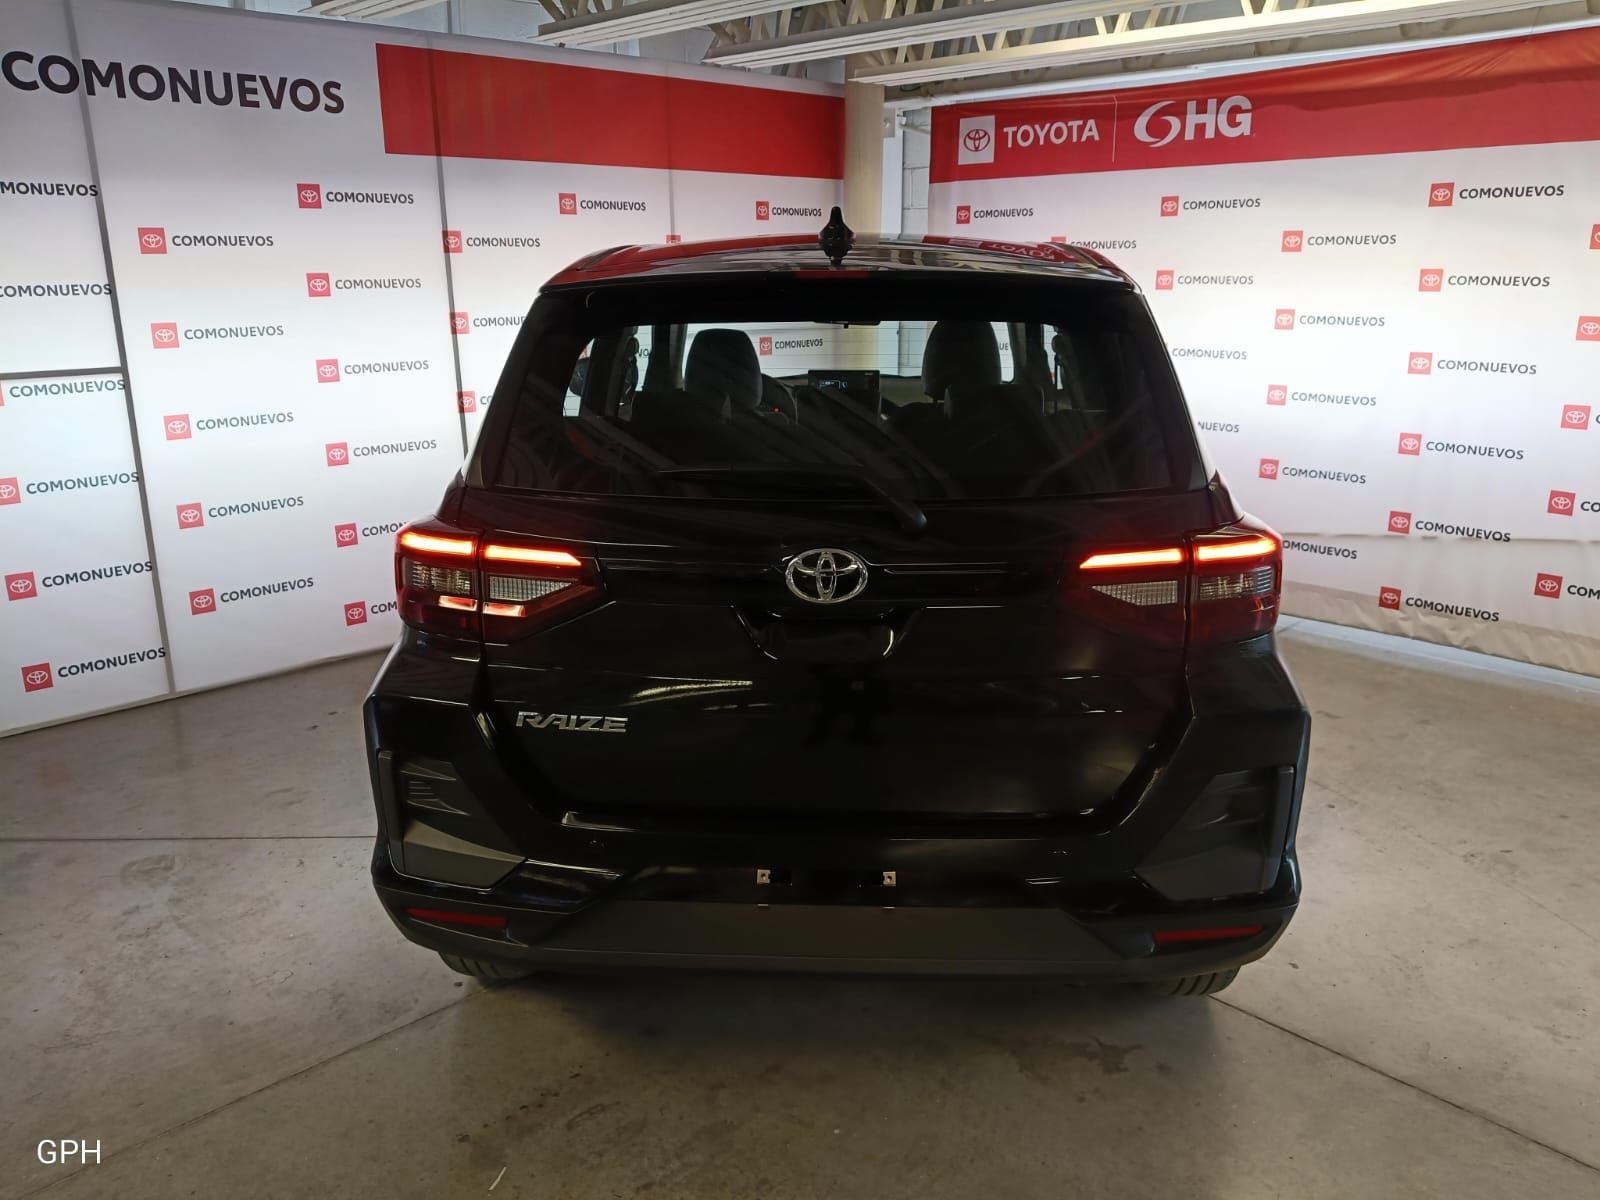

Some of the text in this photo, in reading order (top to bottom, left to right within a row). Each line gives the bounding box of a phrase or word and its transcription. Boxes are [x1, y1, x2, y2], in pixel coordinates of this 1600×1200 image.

[0, 50, 345, 114] COMONUEVOS
[1003, 118, 1100, 149] TOYOTA
[0, 181, 98, 197] MONUEVOS
[1459, 184, 1565, 200] COMONUEVOS
[325, 191, 414, 205] COMONUEVOS
[579, 199, 647, 212] COMONUEVOS
[1182, 197, 1261, 211] COMONUEVOS
[771, 206, 822, 217] COMONUEVOS
[973, 207, 1034, 219] COMONUEVOS
[171, 235, 274, 247] COMONUEVOS
[465, 236, 541, 248] COMONUEVOS
[1307, 234, 1397, 246] COMONUEVOS
[335, 278, 422, 290] COMONUEVOS
[1177, 275, 1254, 285] COMONUEVOS
[1447, 275, 1551, 288] COMONUEVOS
[0, 283, 112, 298] OMONUEVOS
[473, 316, 526, 327] COMONU
[1299, 315, 1385, 327] COMONUEVOS
[183, 325, 284, 340] COMONUEVOS
[774, 337, 823, 350] COMONUEVOS
[1171, 347, 1248, 361] COMONUEVOS
[343, 359, 429, 375] COMONUEVOS
[1437, 359, 1537, 375] COMONUEVOS
[9, 379, 126, 398] COMONUEVOS
[1291, 391, 1377, 407] COMONUEVOS
[196, 411, 294, 431] COMONUEVOS
[1198, 421, 1240, 433] NUEVOS
[353, 439, 437, 457] COMONUEVOS
[1425, 441, 1524, 461] COMONUEVOS
[26, 471, 139, 495] COMONUEVOS
[1281, 466, 1367, 485] COMONUEVOS
[208, 495, 304, 518] COMONUEVOS
[1415, 520, 1512, 543] COMONUEVOS
[1282, 540, 1358, 560] OMONUEVOS
[42, 560, 152, 588] COMONUEVOS
[220, 577, 314, 603] COMONUEVOS
[1405, 597, 1500, 623] COMONUEVOS
[57, 647, 166, 678] COMONUEVOS
[515, 711, 628, 733] RAIZE
